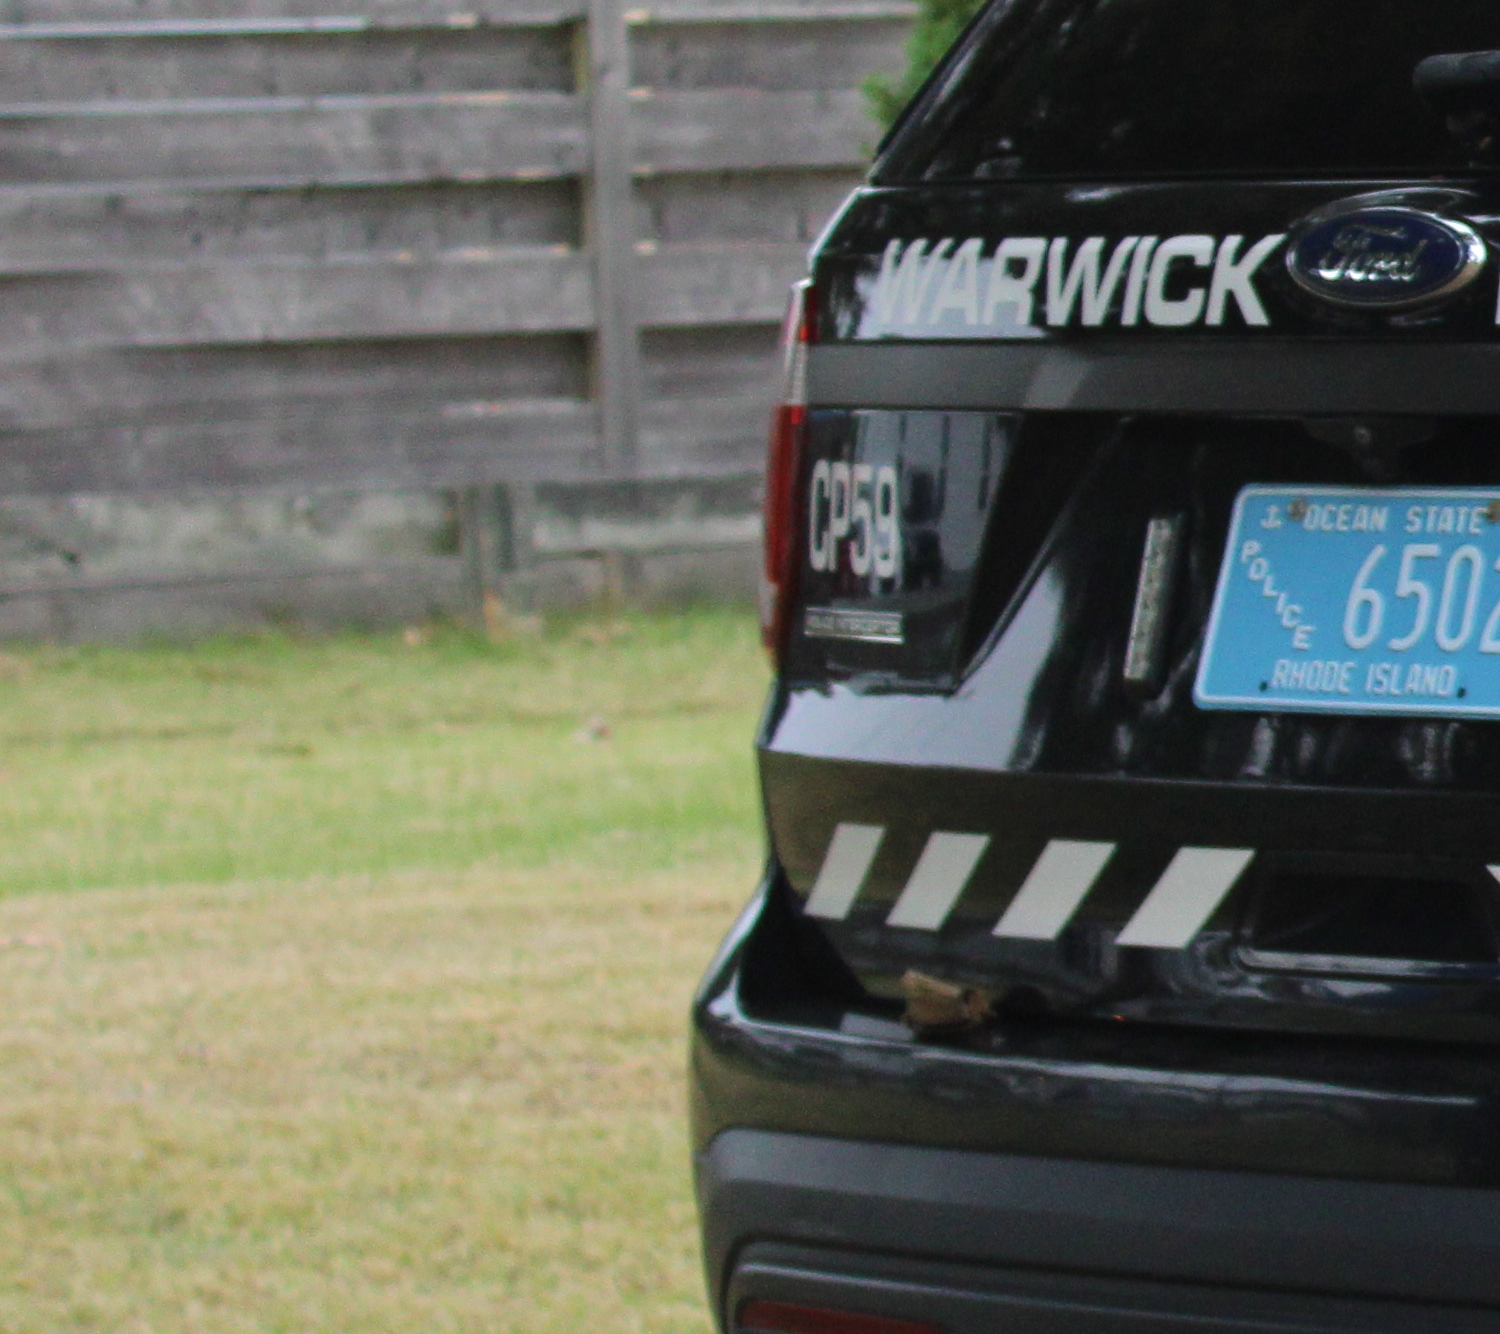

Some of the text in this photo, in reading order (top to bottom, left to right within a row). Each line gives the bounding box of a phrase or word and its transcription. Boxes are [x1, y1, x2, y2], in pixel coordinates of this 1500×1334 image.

[878, 234, 1287, 327] WARWICK
[810, 459, 898, 578] CP59
[1303, 503, 1488, 536] OCEAN STATE
[1241, 539, 1317, 651] POLICE
[1270, 659, 1457, 699] RHODE ISLAND
